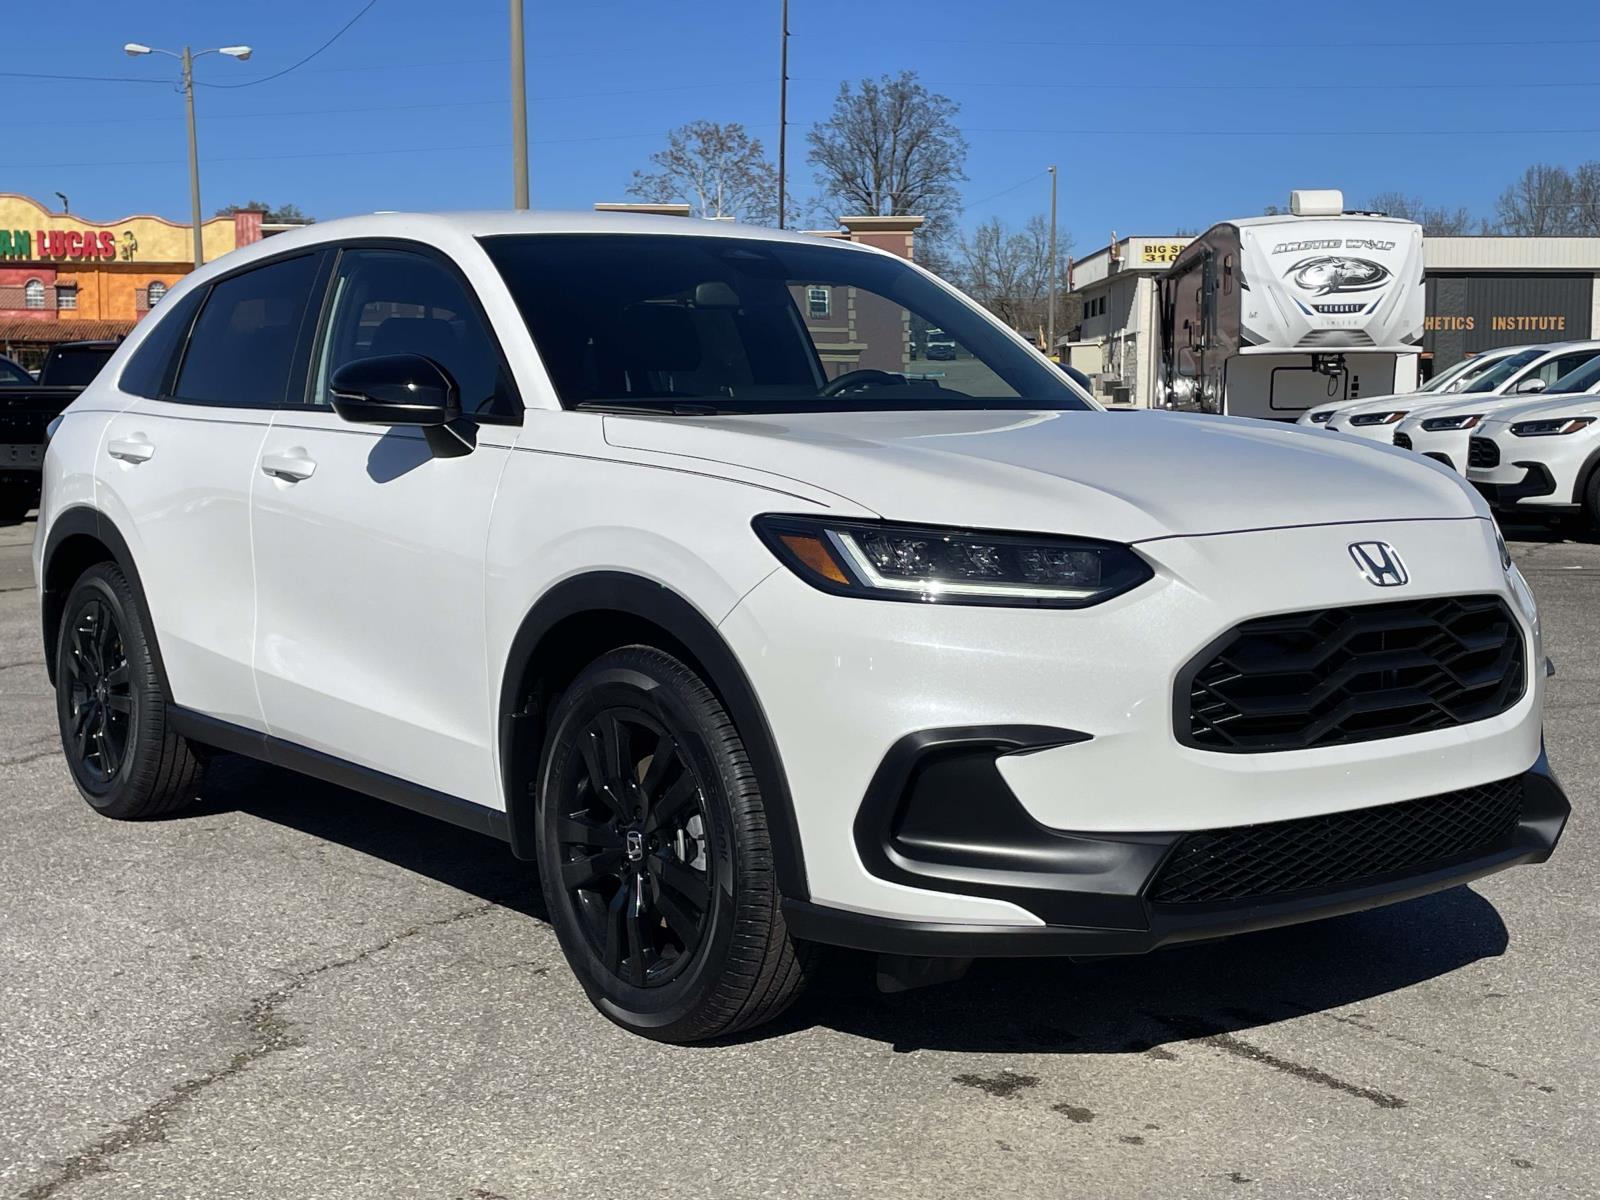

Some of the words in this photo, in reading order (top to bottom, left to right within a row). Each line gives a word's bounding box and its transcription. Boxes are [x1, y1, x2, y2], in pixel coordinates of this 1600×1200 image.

[37, 230, 115, 258] LUCAS
[1144, 245, 1167, 254] BIG
[1272, 239, 1342, 255] ARCTIC
[1318, 304, 1359, 313] CHEROKEE
[1425, 316, 1475, 331] HETICS
[1492, 316, 1566, 331] INSTITUTE
